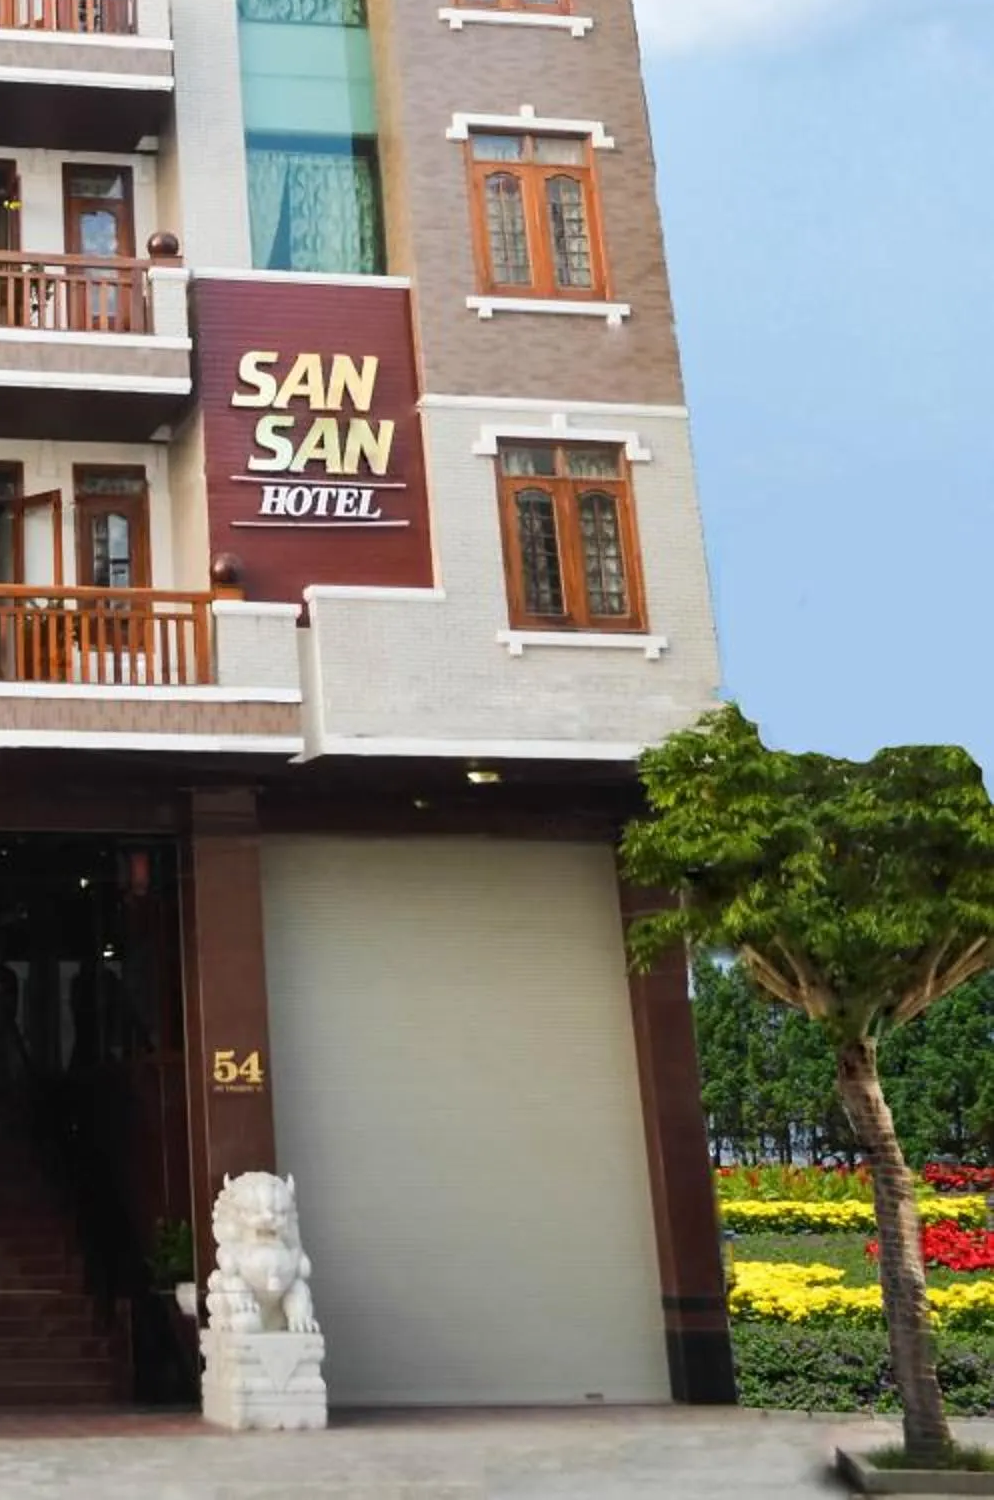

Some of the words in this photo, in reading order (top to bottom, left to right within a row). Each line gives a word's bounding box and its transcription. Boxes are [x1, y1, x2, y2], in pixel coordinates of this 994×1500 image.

[231, 350, 379, 412] SAN
[247, 414, 395, 476] SAN
[258, 485, 382, 519] HOTEL
[213, 1049, 265, 1084] 54
